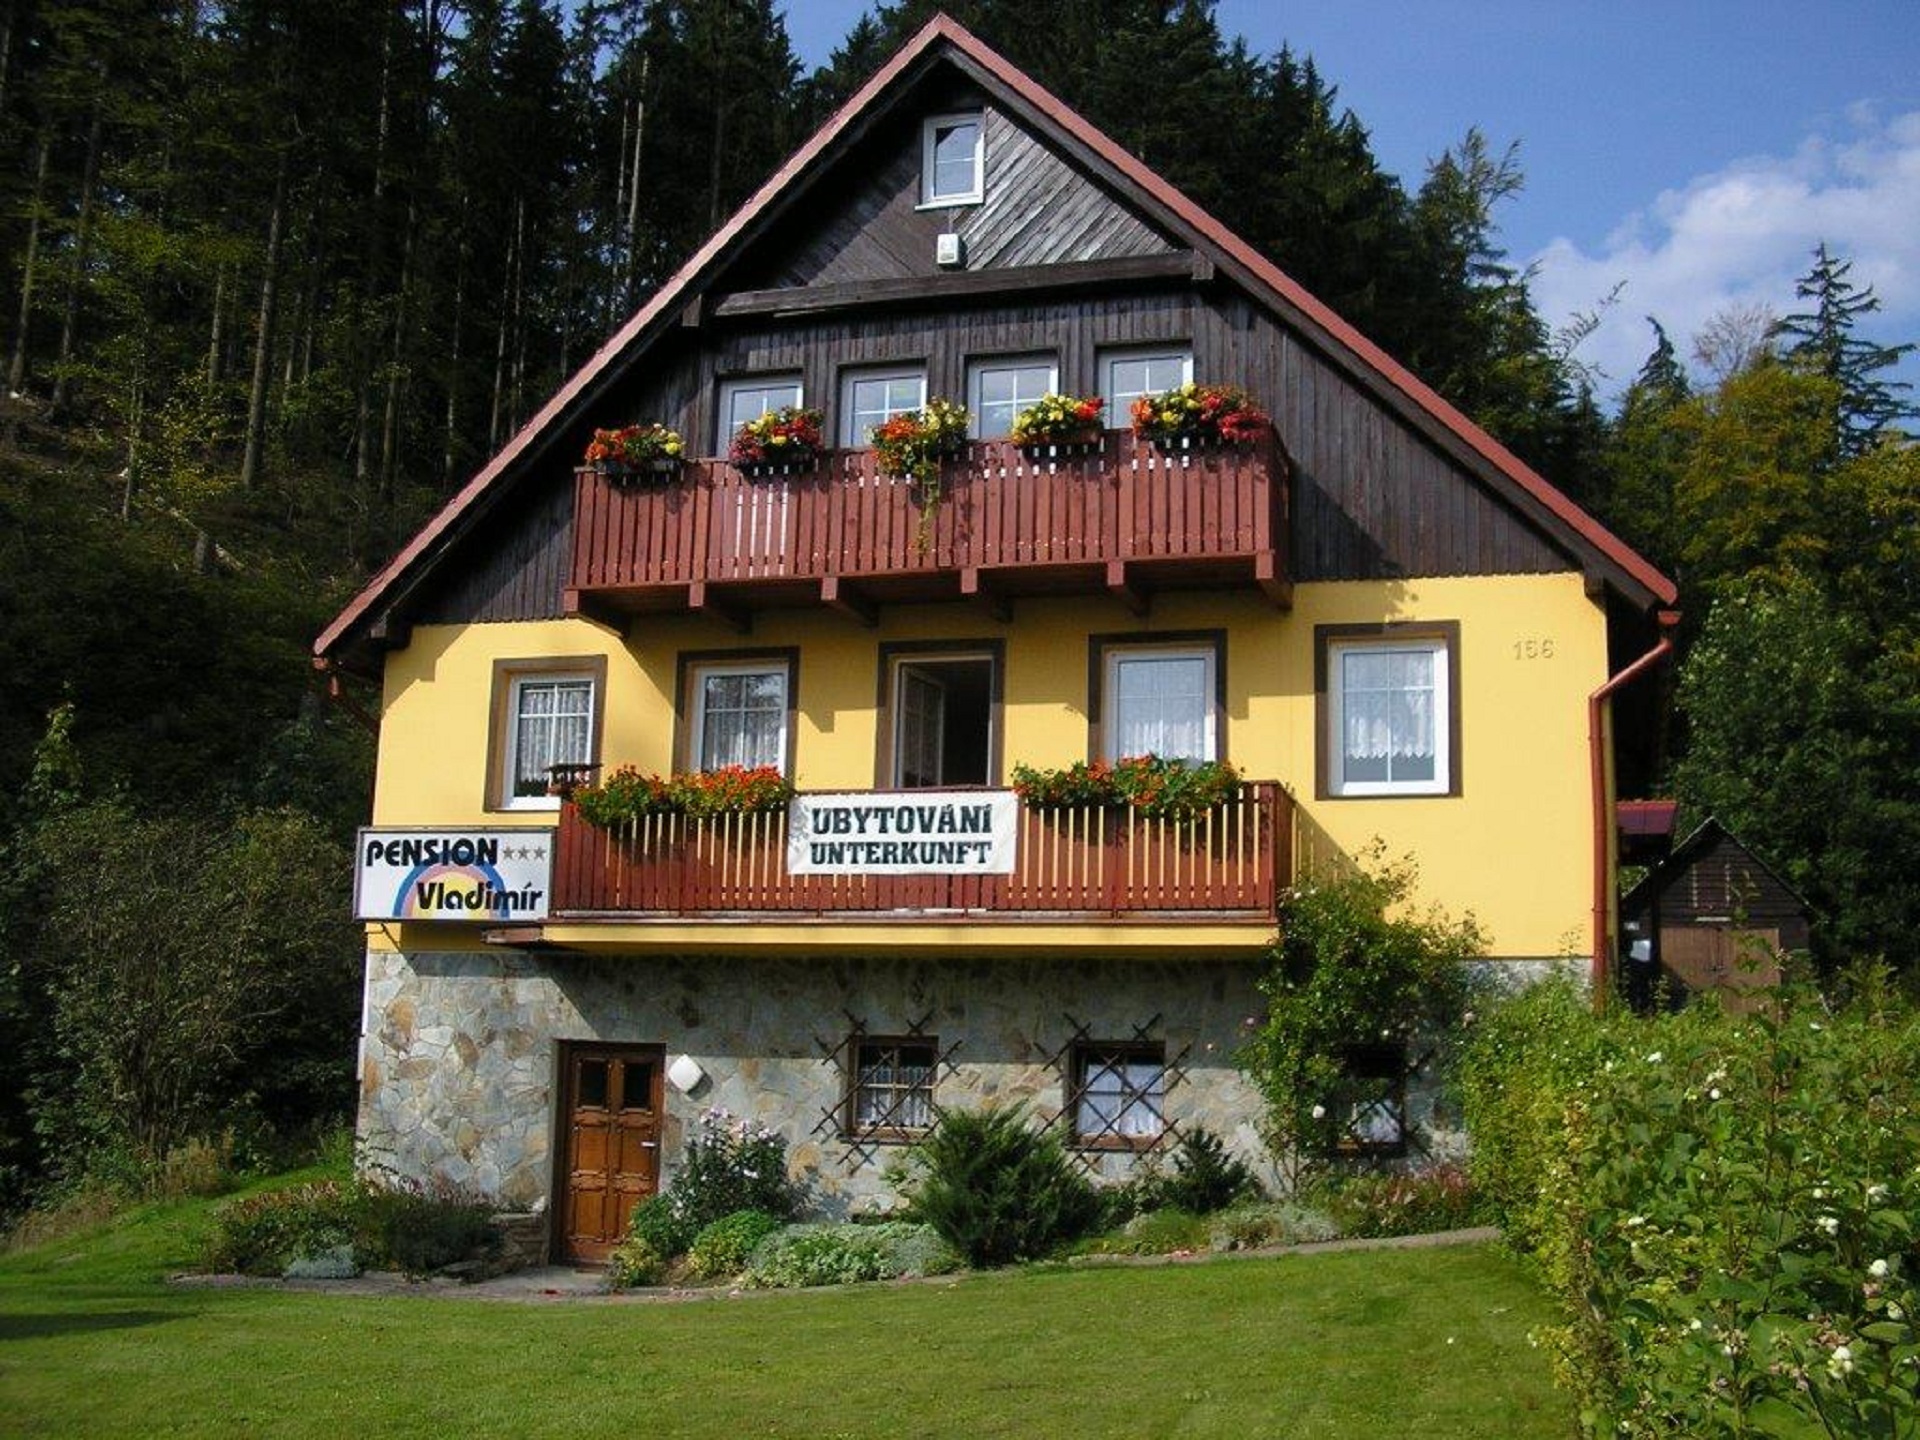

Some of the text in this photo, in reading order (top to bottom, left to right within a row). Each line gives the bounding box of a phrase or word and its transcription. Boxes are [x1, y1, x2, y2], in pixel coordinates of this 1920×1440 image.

[1513, 640, 1554, 660] 156
[812, 804, 993, 835] UBYTOVÁNÍ
[366, 838, 498, 867] PENSION
[810, 840, 993, 865] UNTERKUNFT
[417, 881, 543, 910] Vladimír
